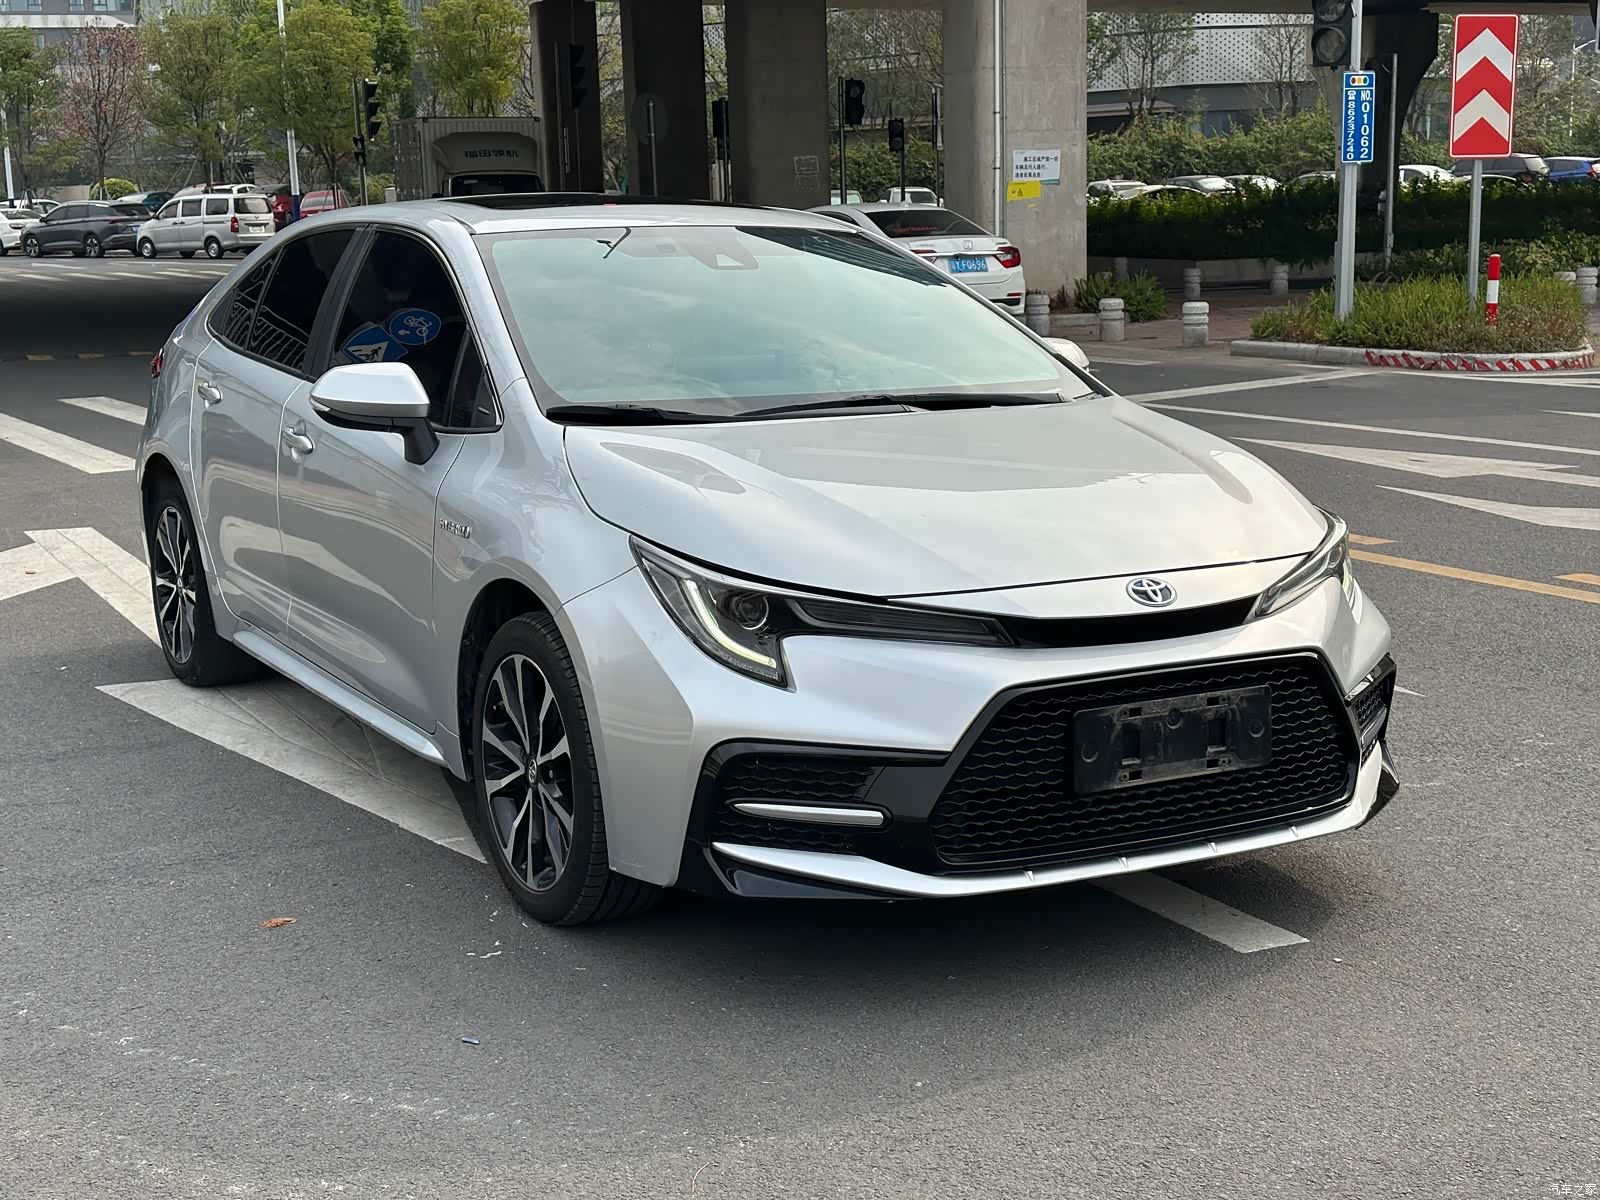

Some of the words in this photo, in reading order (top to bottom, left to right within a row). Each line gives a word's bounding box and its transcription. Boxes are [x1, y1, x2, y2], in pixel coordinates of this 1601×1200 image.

[1360, 90, 1372, 101] NO.
[1346, 101, 1356, 160] 86237240
[1360, 102, 1370, 159] 01062
